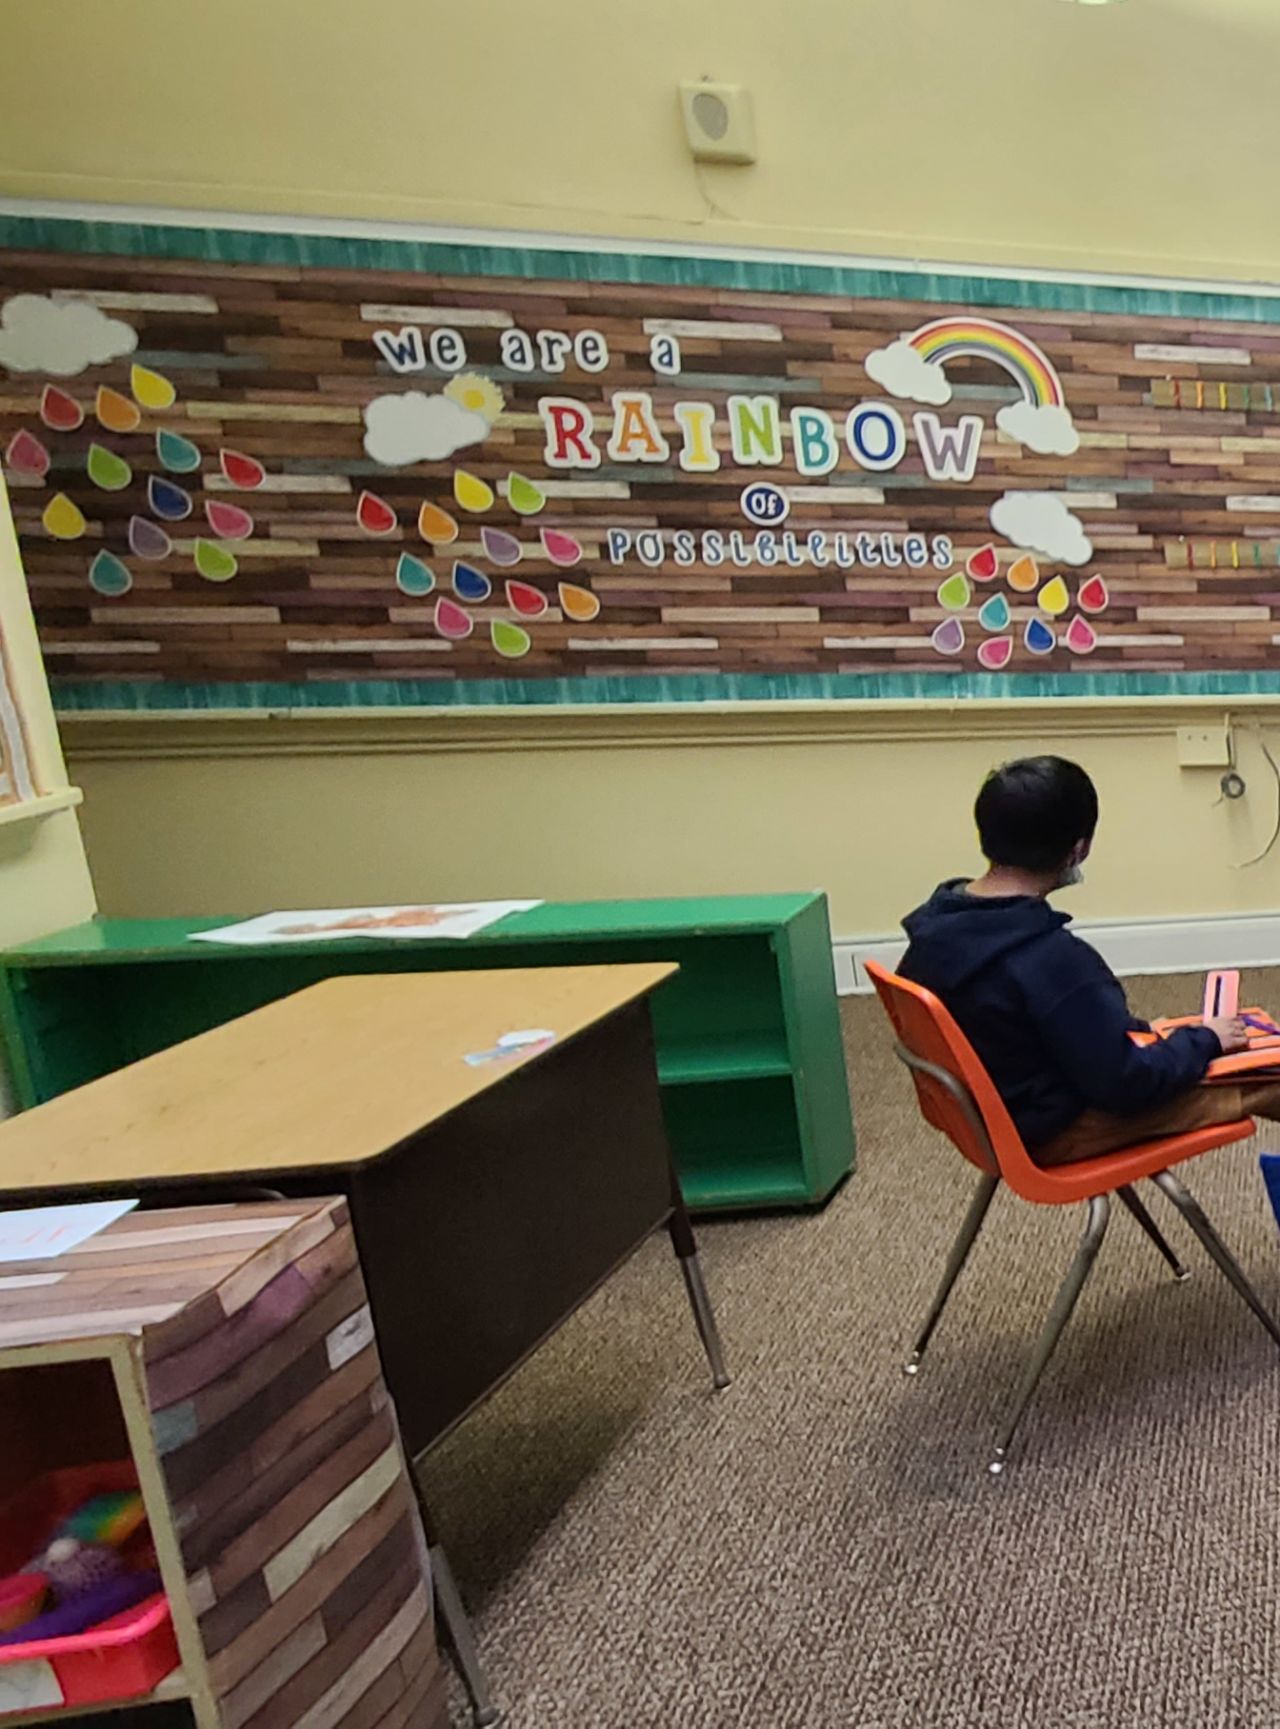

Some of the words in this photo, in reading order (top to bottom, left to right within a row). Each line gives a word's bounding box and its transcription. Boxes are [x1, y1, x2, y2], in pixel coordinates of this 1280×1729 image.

[507, 332, 604, 368] are
[655, 335, 677, 369] a
[547, 399, 976, 478] RAINBOW
